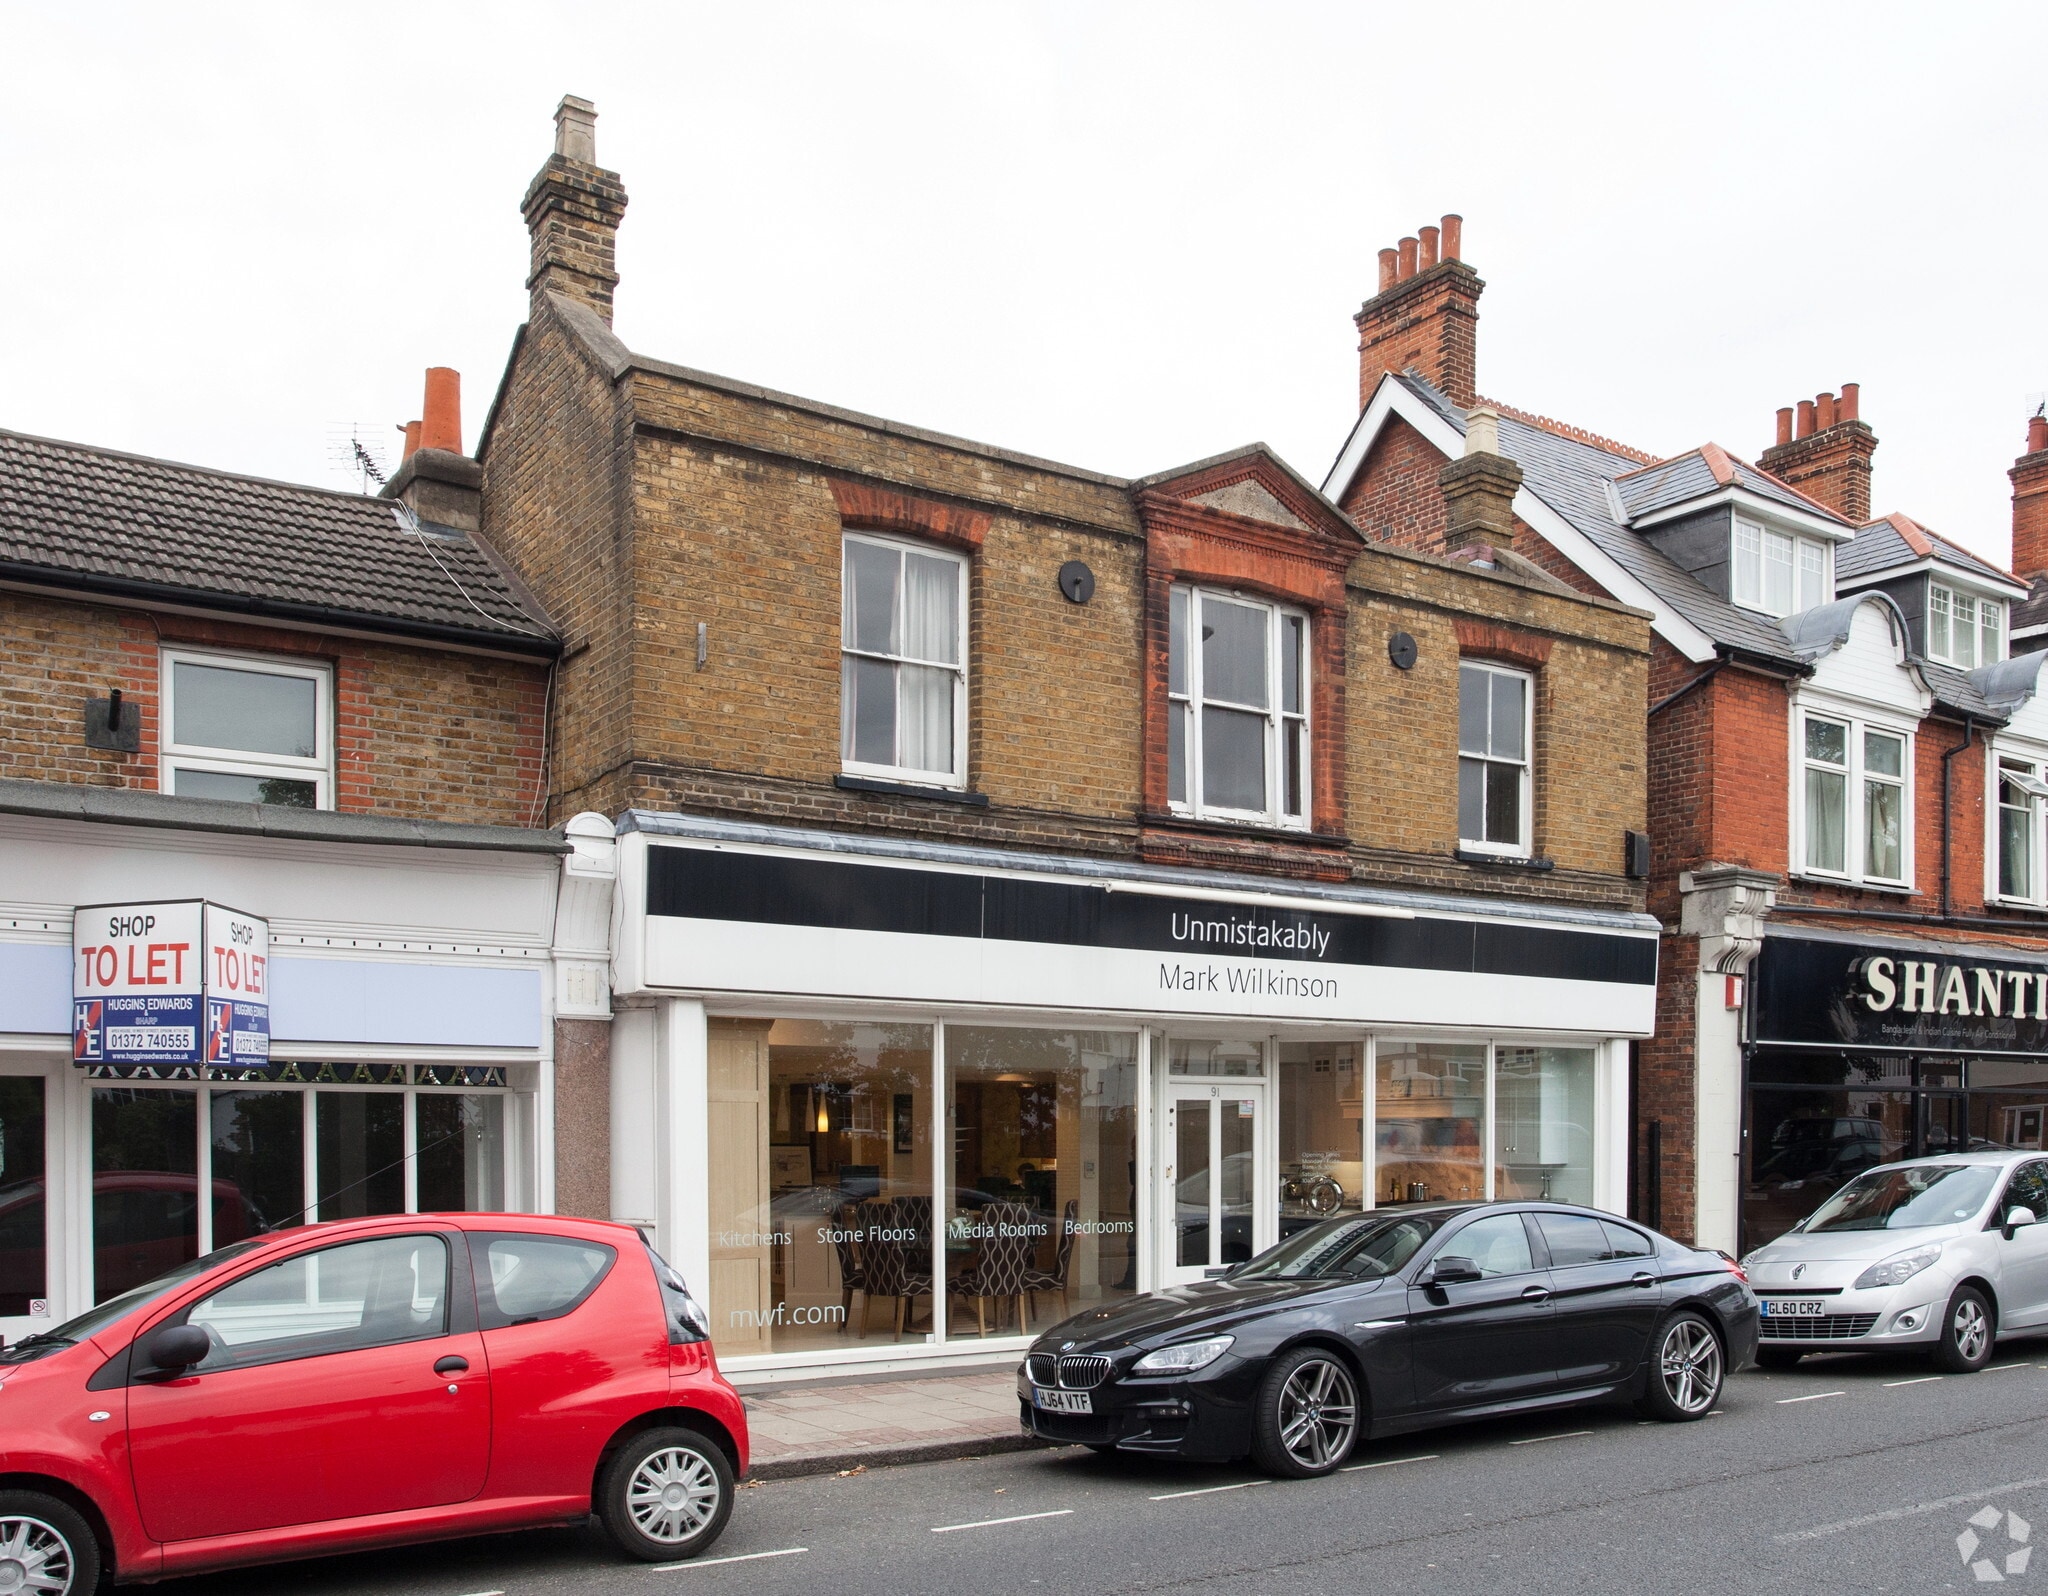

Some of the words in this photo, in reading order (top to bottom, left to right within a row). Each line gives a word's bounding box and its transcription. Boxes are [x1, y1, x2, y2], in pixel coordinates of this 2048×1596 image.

[109, 915, 156, 938] SHOP
[230, 921, 254, 946] SHOP
[1172, 912, 1331, 958] Unmistakably
[81, 944, 118, 987] TO
[127, 942, 190, 986] LET
[213, 945, 240, 991] TO
[243, 951, 266, 995] LET
[1159, 963, 1219, 992] Mark
[1226, 967, 1338, 998] Wilkinson
[1866, 956, 2048, 1020] SHANTI
[108, 998, 146, 1011] HUGGINS
[147, 997, 193, 1010] EDWARDS
[111, 1034, 143, 1048] 01372
[148, 1034, 189, 1048] 740555
[1881, 1024, 1917, 1036] Bangladeshi
[1924, 1026, 1941, 1036] Indian
[1942, 1027, 1961, 1037] Cuisine
[1211, 1087, 1220, 1098] 91
[719, 1230, 792, 1247] Kitchens
[817, 1226, 864, 1244] Stone
[869, 1225, 916, 1243] Floors
[949, 1223, 995, 1239] Media
[999, 1222, 1048, 1237] Rooms
[1065, 1219, 1134, 1235] Bedrooms
[730, 1302, 846, 1328] mwf.com
[1768, 1302, 1797, 1315] GL60
[1799, 1302, 1822, 1315] CRZ
[1038, 1391, 1065, 1409] HJ64
[1065, 1393, 1088, 1410] VTF
